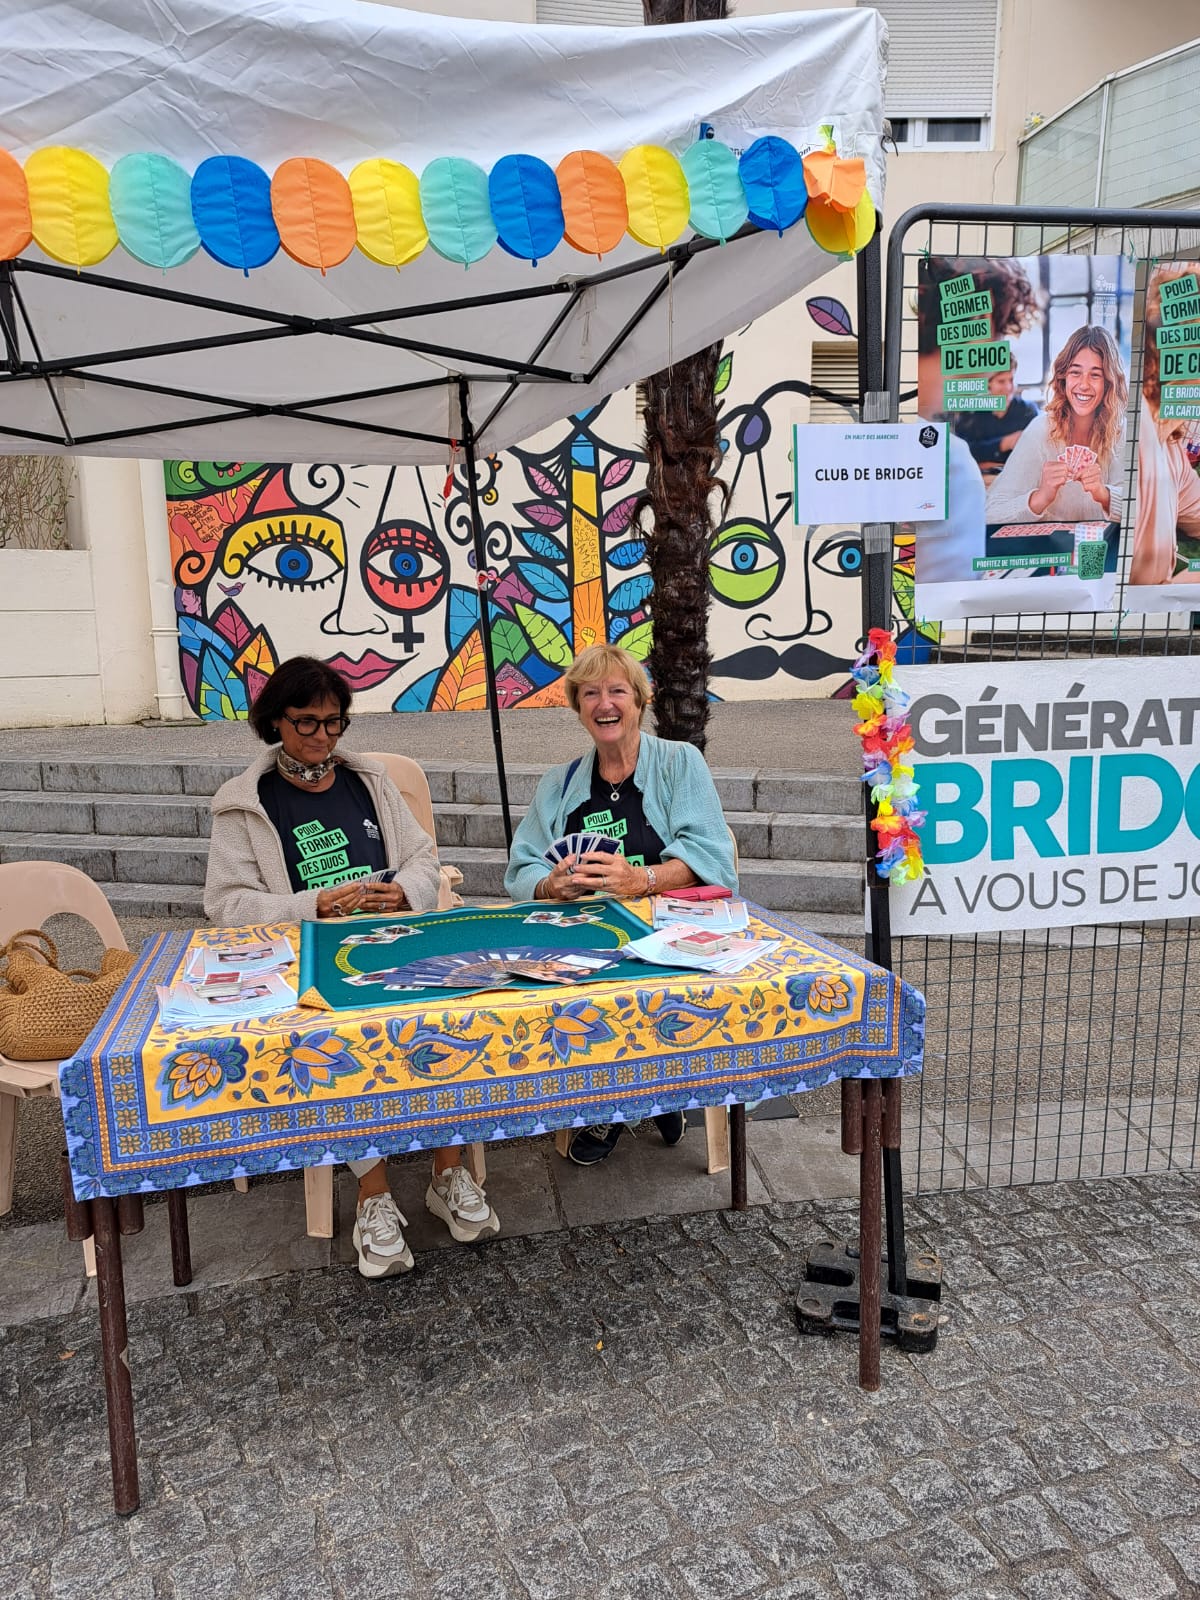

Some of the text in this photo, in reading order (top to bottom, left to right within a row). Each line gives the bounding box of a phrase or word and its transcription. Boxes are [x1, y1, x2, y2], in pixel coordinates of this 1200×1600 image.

[943, 277, 970, 295] POUR
[1164, 278, 1194, 299] POUR
[943, 294, 990, 318] FORMER
[1163, 298, 1200, 320] FORM
[940, 321, 988, 342] DES DUOS
[1160, 329, 1181, 345] DES
[945, 345, 1007, 370] DE CHOC
[1164, 353, 1184, 375] DE
[946, 380, 985, 392] LE BRIDGE
[1164, 387, 1174, 399] LE
[958, 397, 998, 410] CARTONNE
[815, 467, 924, 482] CLUB DE BRIDGE
[529, 532, 561, 561] 1983
[614, 575, 652, 611] 1937
[524, 613, 567, 665] 1975
[587, 812, 609, 826] POUR
[913, 753, 1200, 865] BRID
[297, 823, 320, 838] POUR
[587, 822, 625, 838] MER
[299, 831, 345, 856] FORMER
[302, 854, 345, 877] DES DUOS
[909, 867, 947, 916] À
[955, 868, 1086, 913] VOUS
[1099, 864, 1158, 905] DE
